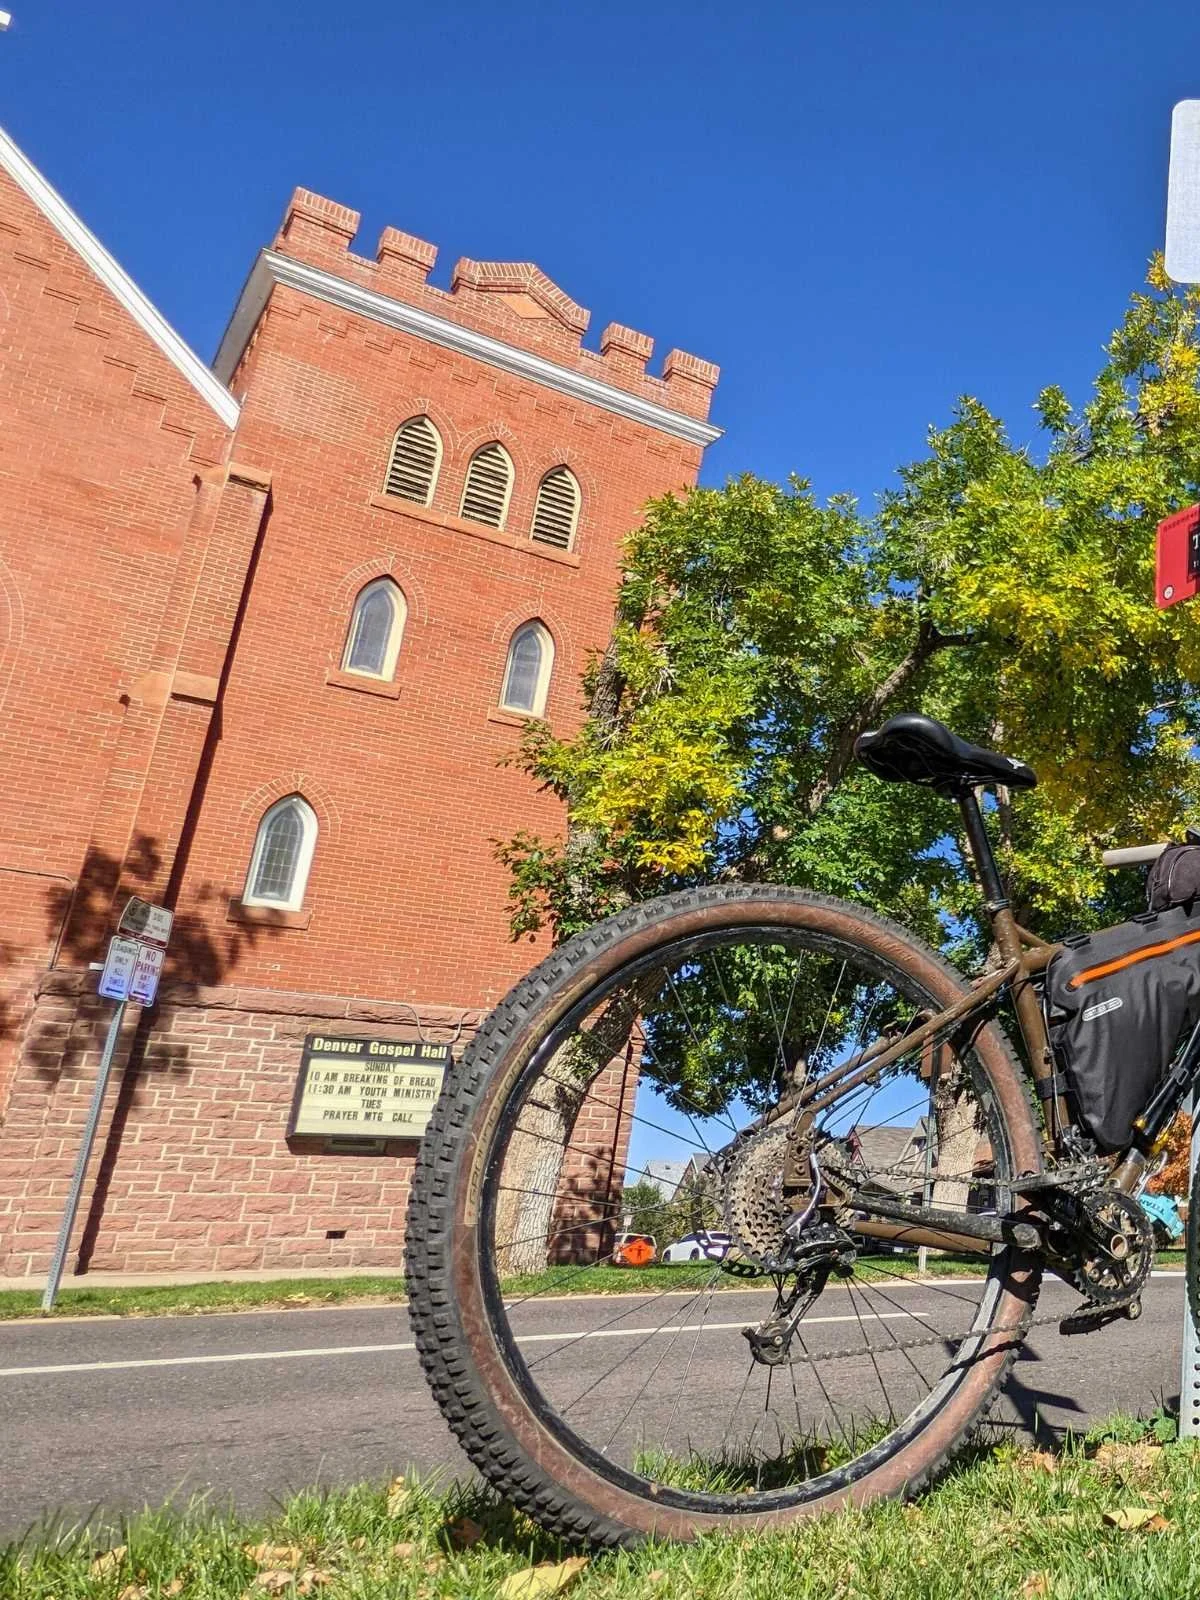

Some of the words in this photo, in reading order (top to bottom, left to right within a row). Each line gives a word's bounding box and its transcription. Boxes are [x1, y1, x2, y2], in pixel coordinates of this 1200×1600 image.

[145, 950, 157, 962] NO
[312, 1038, 364, 1054] Denver
[369, 1042, 416, 1058] Gospel
[421, 1045, 447, 1059] Hall
[364, 1061, 398, 1073] SUNDAY
[310, 1071, 320, 1081] 10
[324, 1072, 338, 1082] AM
[343, 1073, 388, 1085] BREAKING
[393, 1076, 404, 1085] OF
[409, 1077, 437, 1087] BREAD
[308, 1084, 334, 1094] 11:30
[338, 1086, 351, 1095] AM
[360, 1086, 387, 1097] YOUTH
[393, 1088, 438, 1100] MINISTRY
[361, 1098, 382, 1109] TUES
[323, 1110, 358, 1121] PRAYER
[364, 1111, 384, 1122] MTG
